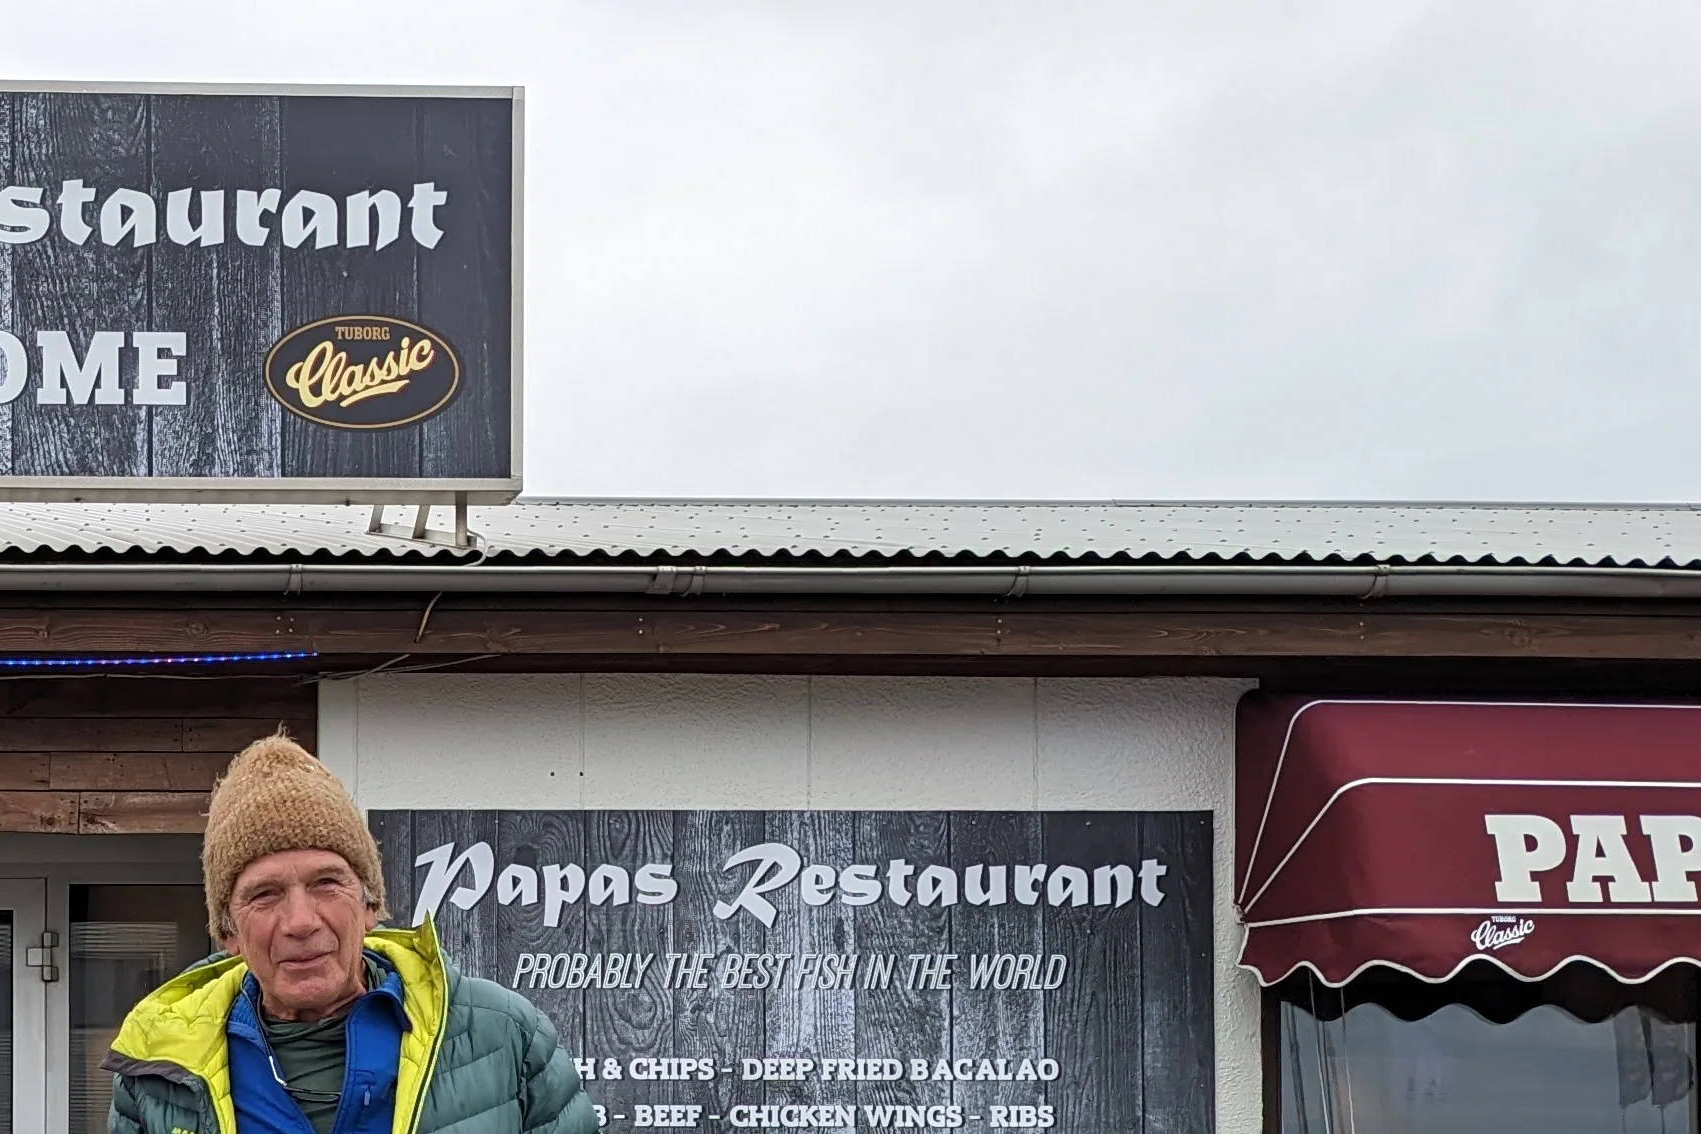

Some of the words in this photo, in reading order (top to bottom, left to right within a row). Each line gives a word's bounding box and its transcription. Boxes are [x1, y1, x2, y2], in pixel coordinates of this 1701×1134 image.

[335, 326, 391, 341] TUBORG
[286, 337, 435, 408] Classic
[412, 841, 678, 927] Papas
[713, 842, 1168, 928] Restaurant
[1471, 919, 1535, 950] Classic
[512, 953, 655, 989] PROBABLY
[663, 953, 714, 989] THE
[720, 953, 792, 989] BEST
[794, 953, 857, 989] FISH
[864, 953, 896, 989] IN
[907, 953, 958, 989] THE
[970, 953, 1068, 989] WORLD
[602, 1058, 622, 1080] &
[629, 1058, 715, 1080] CHIPS
[742, 1058, 814, 1080] DEEP
[822, 1058, 903, 1081] FRIED
[910, 1058, 1060, 1081] BACALAO
[634, 1105, 702, 1127] BEEF
[729, 1105, 856, 1127] CHICKEN
[864, 1105, 963, 1127] WINGS
[990, 1105, 1054, 1127] RIBS
